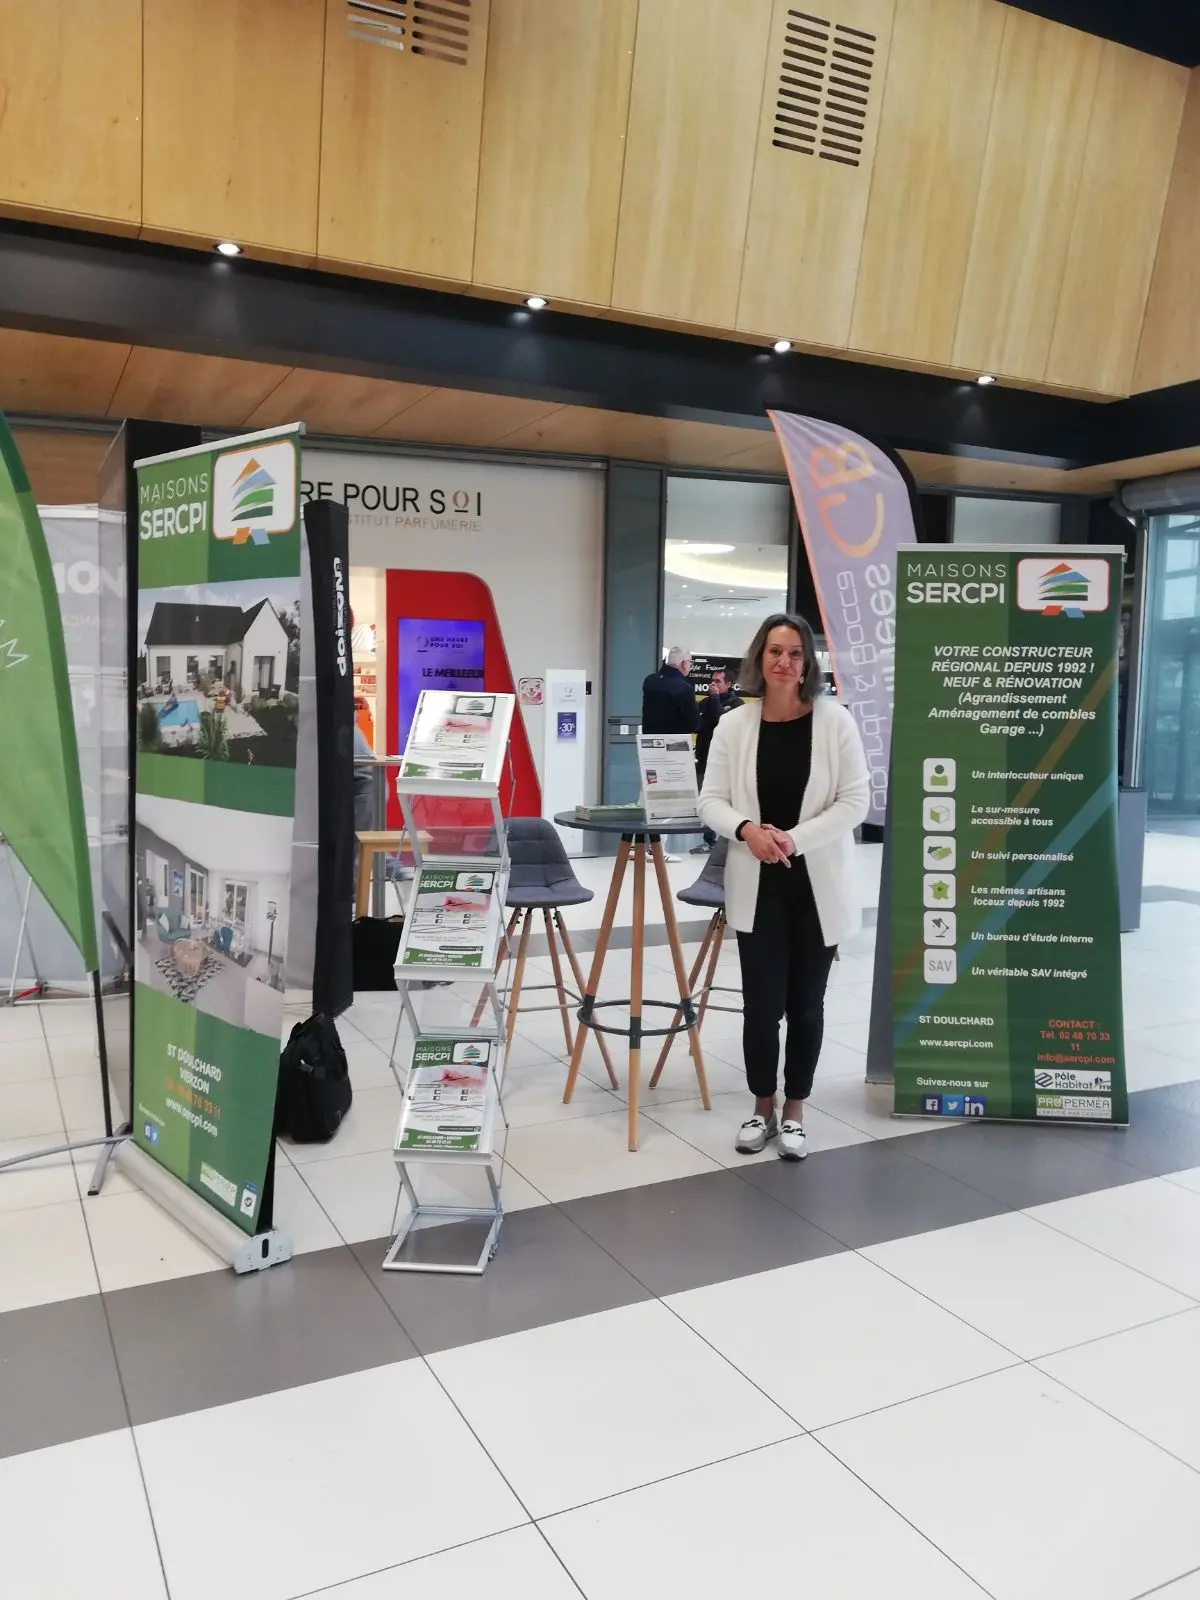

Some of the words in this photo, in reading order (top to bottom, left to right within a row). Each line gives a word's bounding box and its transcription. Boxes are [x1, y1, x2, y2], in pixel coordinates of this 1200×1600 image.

[140, 472, 209, 504] MAISONS
[344, 483, 420, 513] POUR
[140, 500, 207, 540] SERCPI
[395, 516, 482, 533] PARFUMERIE
[907, 563, 1007, 578] MAISONS
[906, 582, 1005, 604] SERCPI
[934, 645, 978, 658] VOTRE
[982, 646, 1093, 659] CONSTRUCTEUR
[422, 668, 433, 677] LE
[931, 659, 1001, 673] RÉGIONAL
[1004, 661, 1054, 674] DEPUIS
[1057, 661, 1087, 674] 1992
[1090, 661, 1095, 674] !
[943, 676, 980, 688] NEUF
[983, 676, 993, 688] &
[995, 673, 1083, 689] RÉNOVATION
[958, 692, 1067, 705] (Agrandissement
[928, 707, 1020, 720] Aménagement
[1023, 708, 1039, 720] de
[1042, 708, 1096, 720] combles
[979, 723, 1026, 737] Garage
[971, 770, 985, 780] Un
[987, 770, 1049, 781] interlocuteur
[1051, 771, 1084, 782] unique
[971, 804, 984, 814] Le
[985, 806, 1040, 815] sur-mesure
[971, 818, 1022, 826] accessible
[1024, 818, 1031, 827] à
[1032, 818, 1054, 827] tous
[971, 850, 985, 860] Un
[987, 851, 1011, 861] suivi
[1012, 851, 1075, 862] personnalisé
[971, 885, 988, 895] Les
[991, 886, 1025, 895] mêmes
[1027, 887, 1066, 896] artisans
[973, 898, 1005, 907] locaux
[1007, 898, 1040, 909] depuis
[1043, 899, 1065, 908] 1992
[971, 932, 985, 942] Un
[987, 932, 1021, 942] bureau
[1022, 932, 1058, 943] d'étude
[1060, 934, 1094, 944] interne
[928, 960, 953, 973] SAV
[971, 966, 985, 977] Un
[987, 967, 1030, 978] véritable
[1031, 968, 1052, 978] SAV
[1054, 969, 1088, 980] intégré
[919, 1015, 932, 1025] ST
[934, 1016, 994, 1026] DOULCHARD
[1048, 1019, 1095, 1029] CONTACT
[1059, 1031, 1070, 1040] 02
[919, 1039, 994, 1050] www.sercpi.com
[1070, 1042, 1081, 1051] 11
[415, 1052, 451, 1061] SERCPI
[178, 1048, 222, 1083] DOULCHARD
[1054, 1071, 1076, 1081] Pôle
[916, 1076, 972, 1088] Suivez-nous
[974, 1080, 990, 1089] sur
[1055, 1080, 1093, 1089] Habitat
